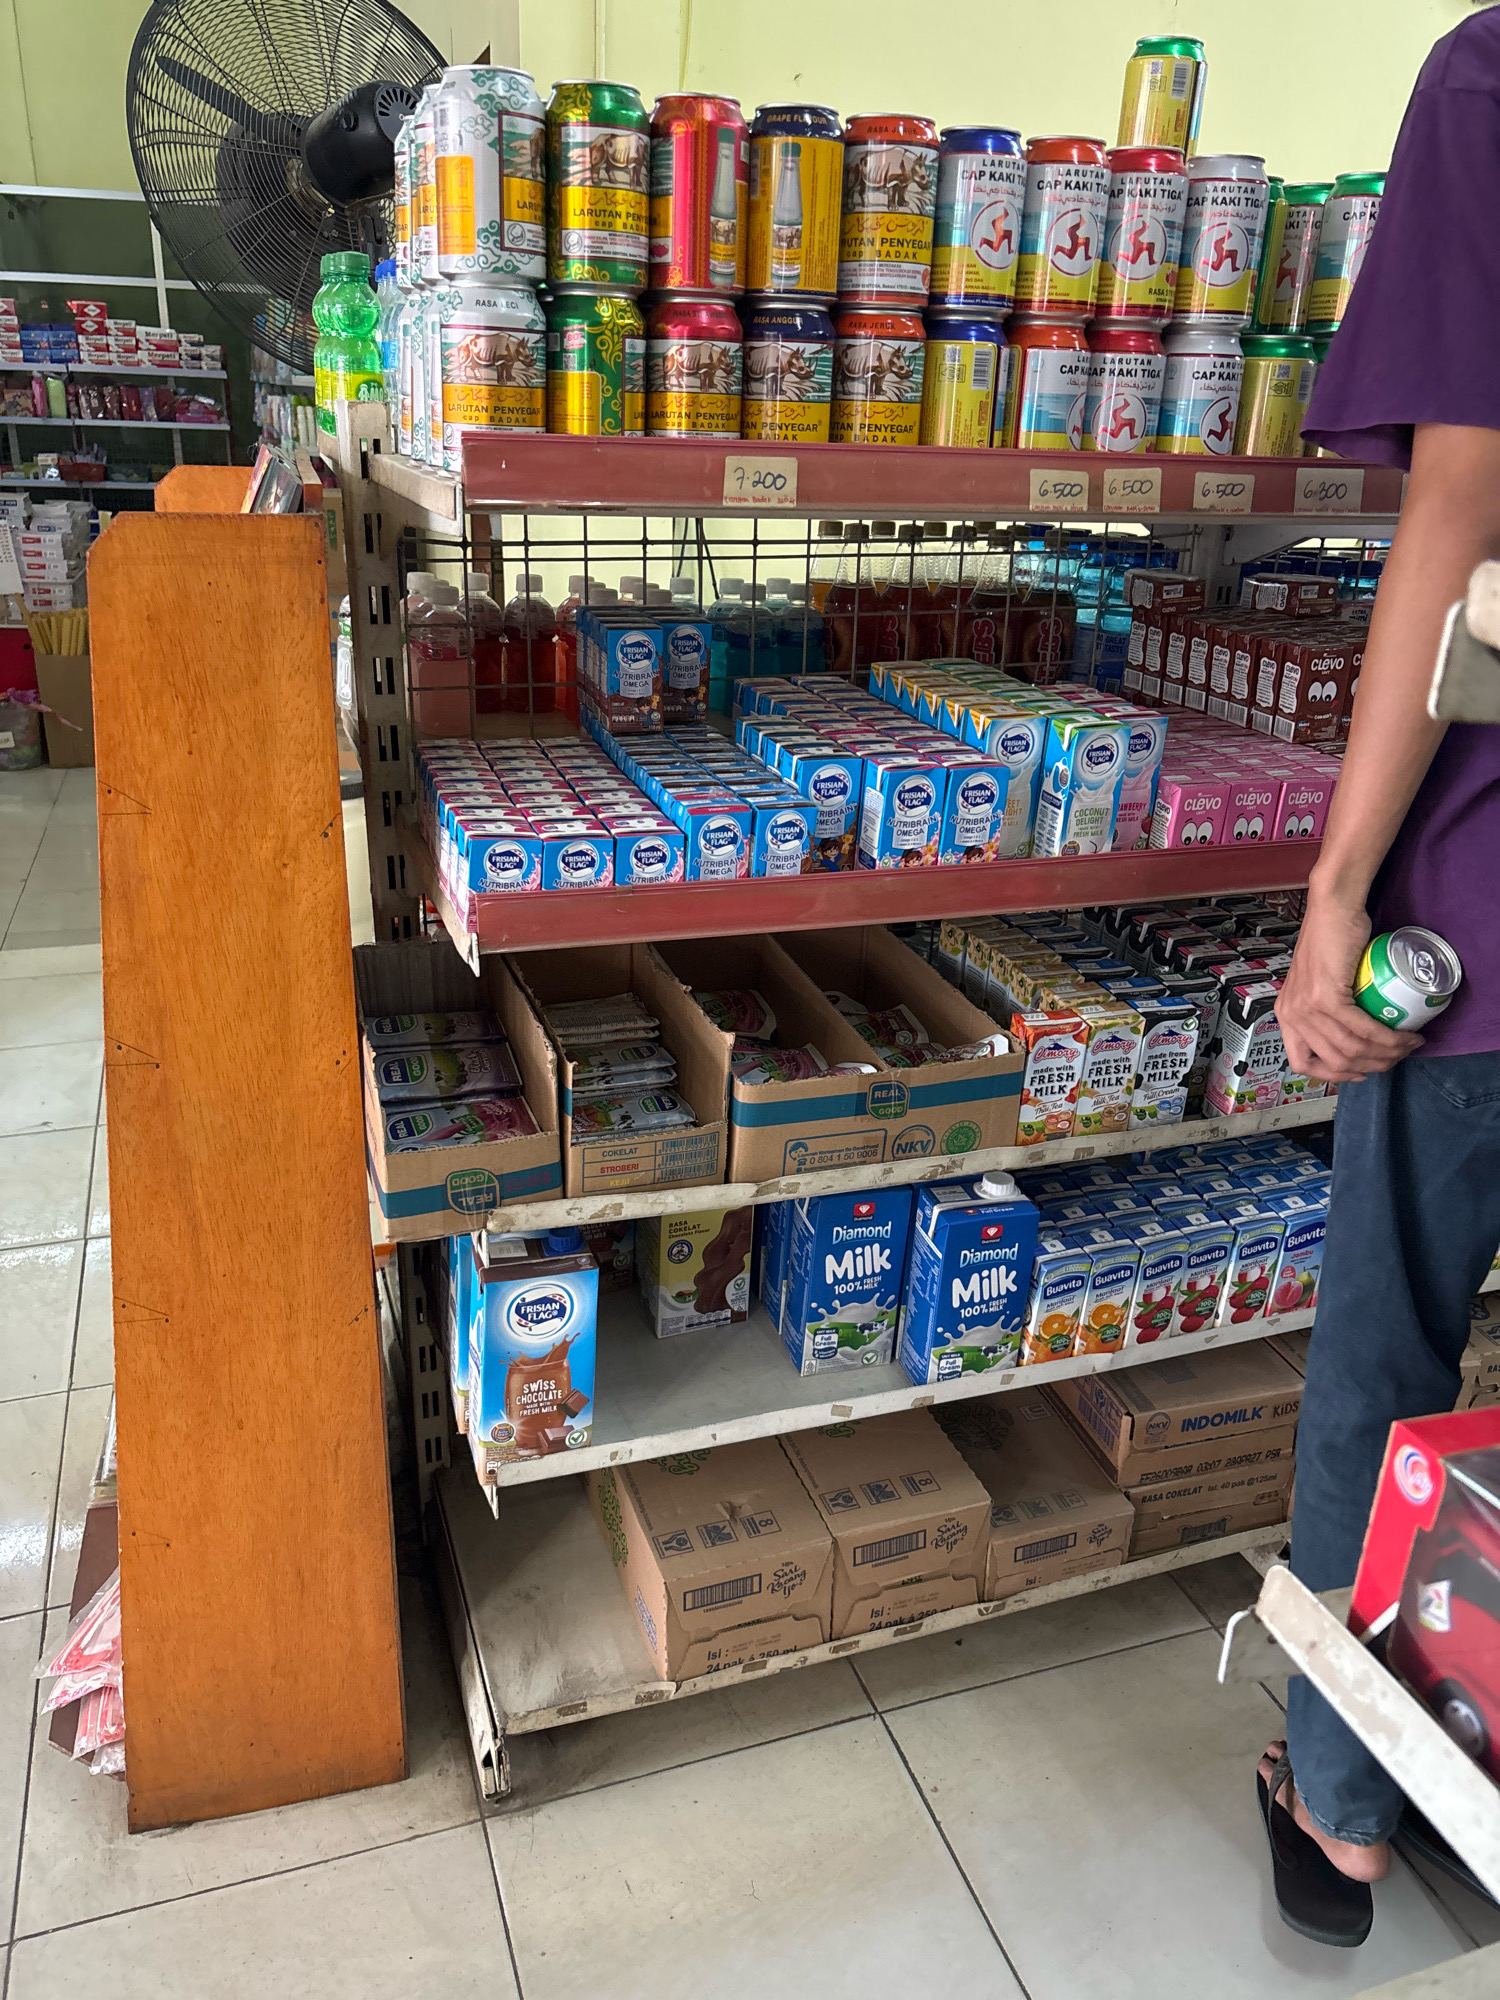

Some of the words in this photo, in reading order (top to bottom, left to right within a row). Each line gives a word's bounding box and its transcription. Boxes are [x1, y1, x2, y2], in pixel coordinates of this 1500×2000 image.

[990, 171, 1015, 182] KAKI
[1058, 169, 1105, 179] LARUTAN
[1037, 181, 1060, 190] CAP
[1065, 181, 1092, 191] KAKI
[1121, 177, 1172, 185] LARUTAN
[1127, 188, 1156, 198] KAKI
[1161, 189, 1183, 200] TIGA
[1211, 197, 1241, 206] KAKI
[574, 208, 621, 220] LARUTAN
[880, 238, 931, 250] PENYEGAR
[877, 250, 918, 260] BADAK
[475, 299, 497, 308] RASA
[1103, 357, 1152, 366] LARUTAN
[1060, 365, 1080, 375] CAP
[1109, 367, 1137, 377] KAKI
[1141, 369, 1161, 379] TIGA
[1192, 371, 1215, 380] CAP
[448, 403, 489, 414] LARUTAN
[493, 405, 541, 415] PENYEGAR
[463, 414, 480, 422] cap
[490, 416, 527, 424] BADAK
[652, 411, 691, 419] LARUTAN
[761, 422, 818, 432] PENYEGAR
[859, 423, 914, 434] PENYEGAR
[1039, 480, 1083, 499] 6.500
[1109, 478, 1153, 496] 6.500
[1202, 482, 1245, 498] 6.500
[613, 670, 660, 679] NUTRIBRAIN
[900, 792, 927, 801] FRISIAN
[964, 790, 991, 799] FRISIAN
[1074, 808, 1111, 818] COCONUT
[887, 815, 938, 828] NUTRIBRAIN
[950, 813, 1000, 825] NUTRIBRAIN
[1075, 817, 1104, 826] DELIGHT
[707, 831, 734, 840] FRISIAN
[773, 826, 800, 835] FRISIAN
[896, 828, 925, 837] OMEGA
[959, 826, 988, 834] OMEGA
[492, 855, 519, 863] FRISIAN
[565, 855, 592, 863] FRISIAN
[760, 850, 810, 863] NUTRIBRAIN
[704, 867, 733, 876] OMEGA
[769, 862, 798, 870] OMEGA
[479, 878, 530, 888] NUTRIBRAIN
[553, 877, 602, 888] NUTRIBRAIN
[625, 873, 673, 884] NUTRIBRAIN
[1148, 1032, 1193, 1049] Cimory
[1092, 1038, 1136, 1056] Cimory
[1033, 1046, 1080, 1063] Cimory
[1144, 1058, 1188, 1071] FRESH
[1251, 1056, 1281, 1068] MILK
[393, 1061, 403, 1082] REAL
[1033, 1067, 1053, 1075] made
[1088, 1064, 1132, 1078] FRESH
[1147, 1071, 1180, 1082] MILK
[1030, 1072, 1075, 1086] FRESH
[1091, 1077, 1125, 1088] MILK
[874, 1089, 900, 1099] REAL
[1034, 1085, 1068, 1097] MILK
[879, 1106, 903, 1115] GOOD
[397, 1120, 409, 1139] REAL
[896, 1139, 931, 1154] NKV
[602, 1148, 638, 1157] COKELAT
[810, 1156, 815, 1164] 0
[818, 1155, 833, 1163] 804
[600, 1163, 639, 1174] STROBERI
[669, 1220, 688, 1228] RASA
[669, 1223, 701, 1234] COKELAT
[832, 1221, 892, 1245] Diamond
[1288, 1227, 1326, 1248] Buavita
[1241, 1241, 1275, 1256] Buavita
[959, 1243, 1019, 1268] Diamond
[1190, 1249, 1225, 1265] Buavita
[825, 1243, 891, 1285] Milk
[1146, 1259, 1180, 1277] Buavita
[864, 1275, 882, 1284] FRESH
[1095, 1269, 1131, 1286] Buavita
[834, 1280, 862, 1295] 100%
[864, 1282, 878, 1291] MILK
[952, 1265, 1017, 1308] Milk
[1046, 1279, 1082, 1296] Buavita
[521, 1302, 560, 1314] FRISIAN
[989, 1297, 1007, 1308] FRESH
[960, 1303, 988, 1318] 100%
[989, 1304, 1004, 1313] MILK
[523, 1379, 556, 1394] SWISS
[516, 1389, 562, 1405] CHOCOLATE
[519, 1407, 540, 1417] FRESH
[541, 1403, 557, 1413] MILK
[1181, 1406, 1264, 1432] INDOMILK
[1141, 1491, 1163, 1503] RASA
[1166, 1486, 1202, 1499] COKELAT
[871, 1608, 884, 1618] Isi
[708, 1649, 721, 1660] Isi
